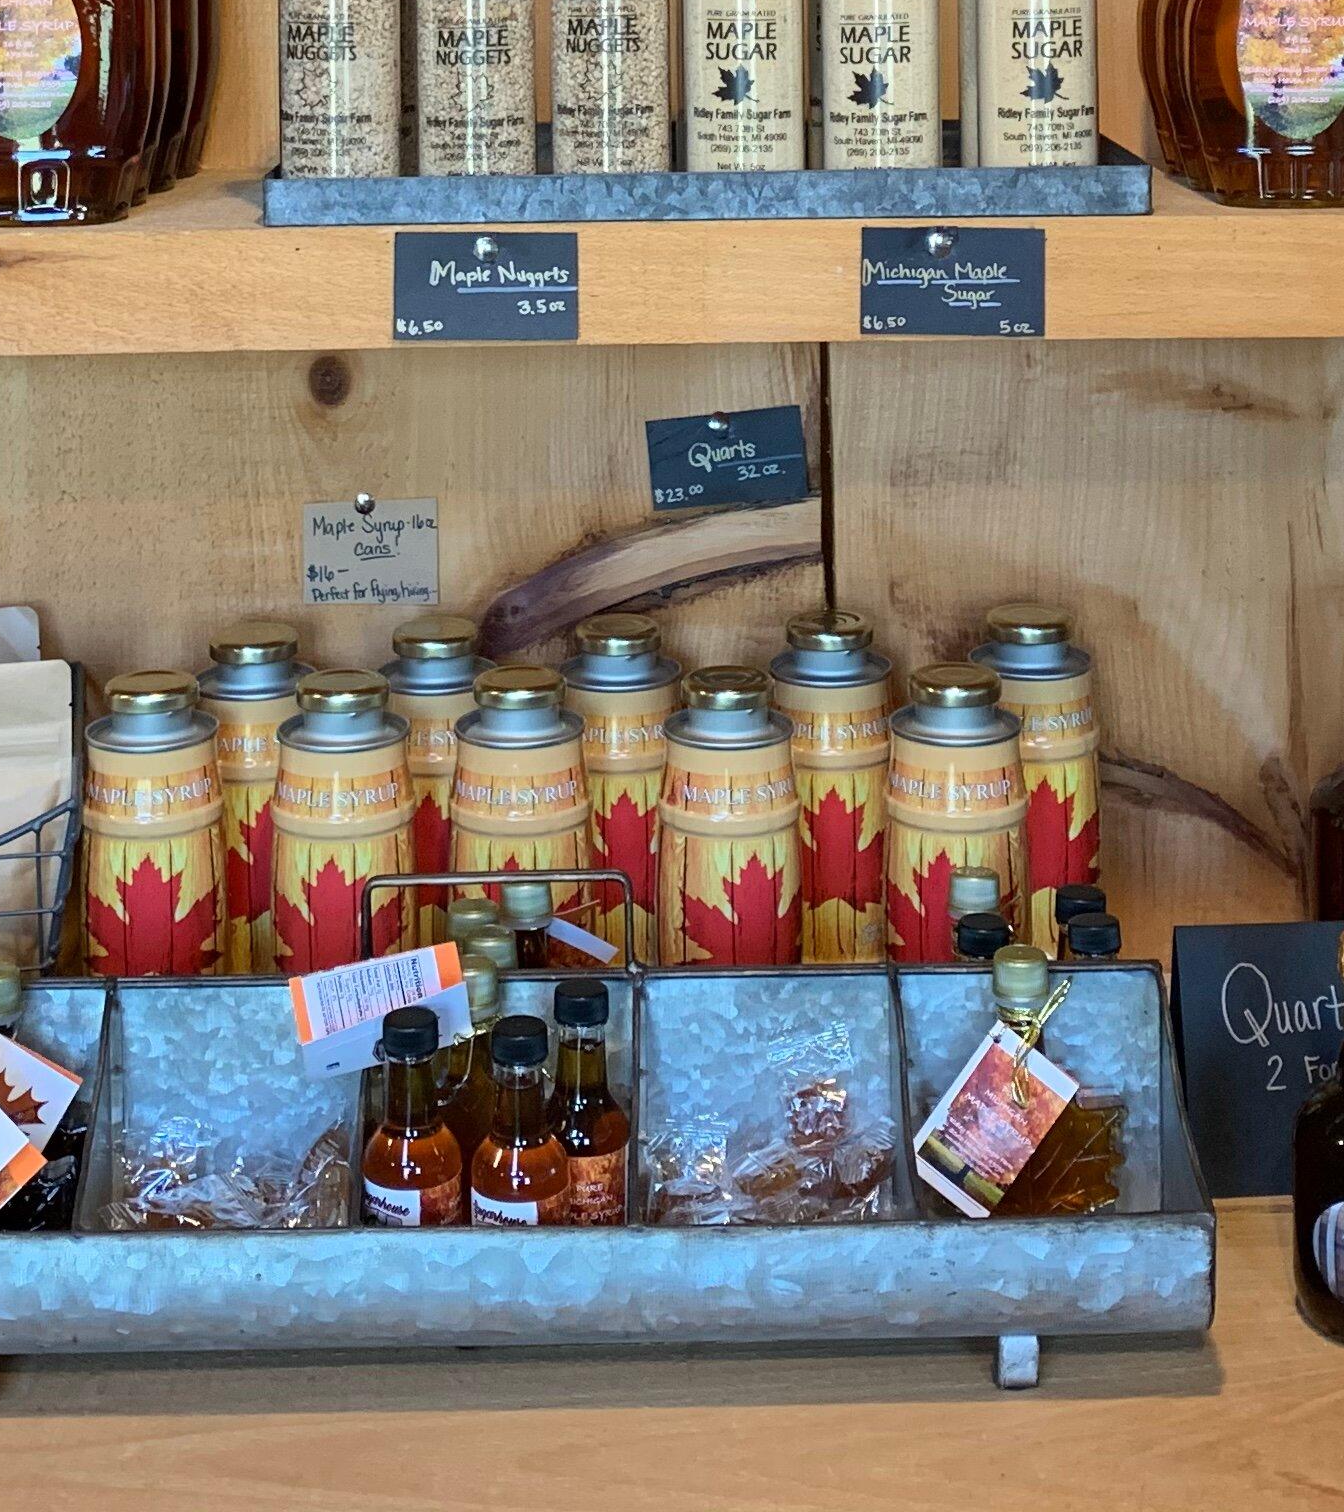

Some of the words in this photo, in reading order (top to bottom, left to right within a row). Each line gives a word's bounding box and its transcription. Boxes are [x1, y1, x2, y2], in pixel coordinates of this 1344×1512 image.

[706, 22, 777, 39] MAPLE
[1011, 18, 1083, 39] MAPLE
[706, 42, 777, 60] SUGAR
[1011, 40, 1083, 60] SUGAR
[429, 260, 491, 287] Maple
[497, 260, 570, 288] Nuggets
[862, 259, 948, 288] Michigan
[954, 262, 1007, 285] Maple
[517, 299, 547, 315] 3.5
[549, 300, 566, 312] oz
[941, 283, 996, 309] Sugar
[999, 320, 1010, 334] 5
[688, 439, 756, 473] Quarts
[737, 465, 761, 481] 32
[312, 516, 355, 541] Maple
[312, 588, 350, 602] Perfect
[353, 582, 368, 600] for
[88, 783, 146, 806] MAPLE
[151, 777, 212, 804] SYRUP
[456, 780, 512, 805] MAPLE
[516, 780, 576, 804] SYRUP
[1265, 1055, 1287, 1092] 2
